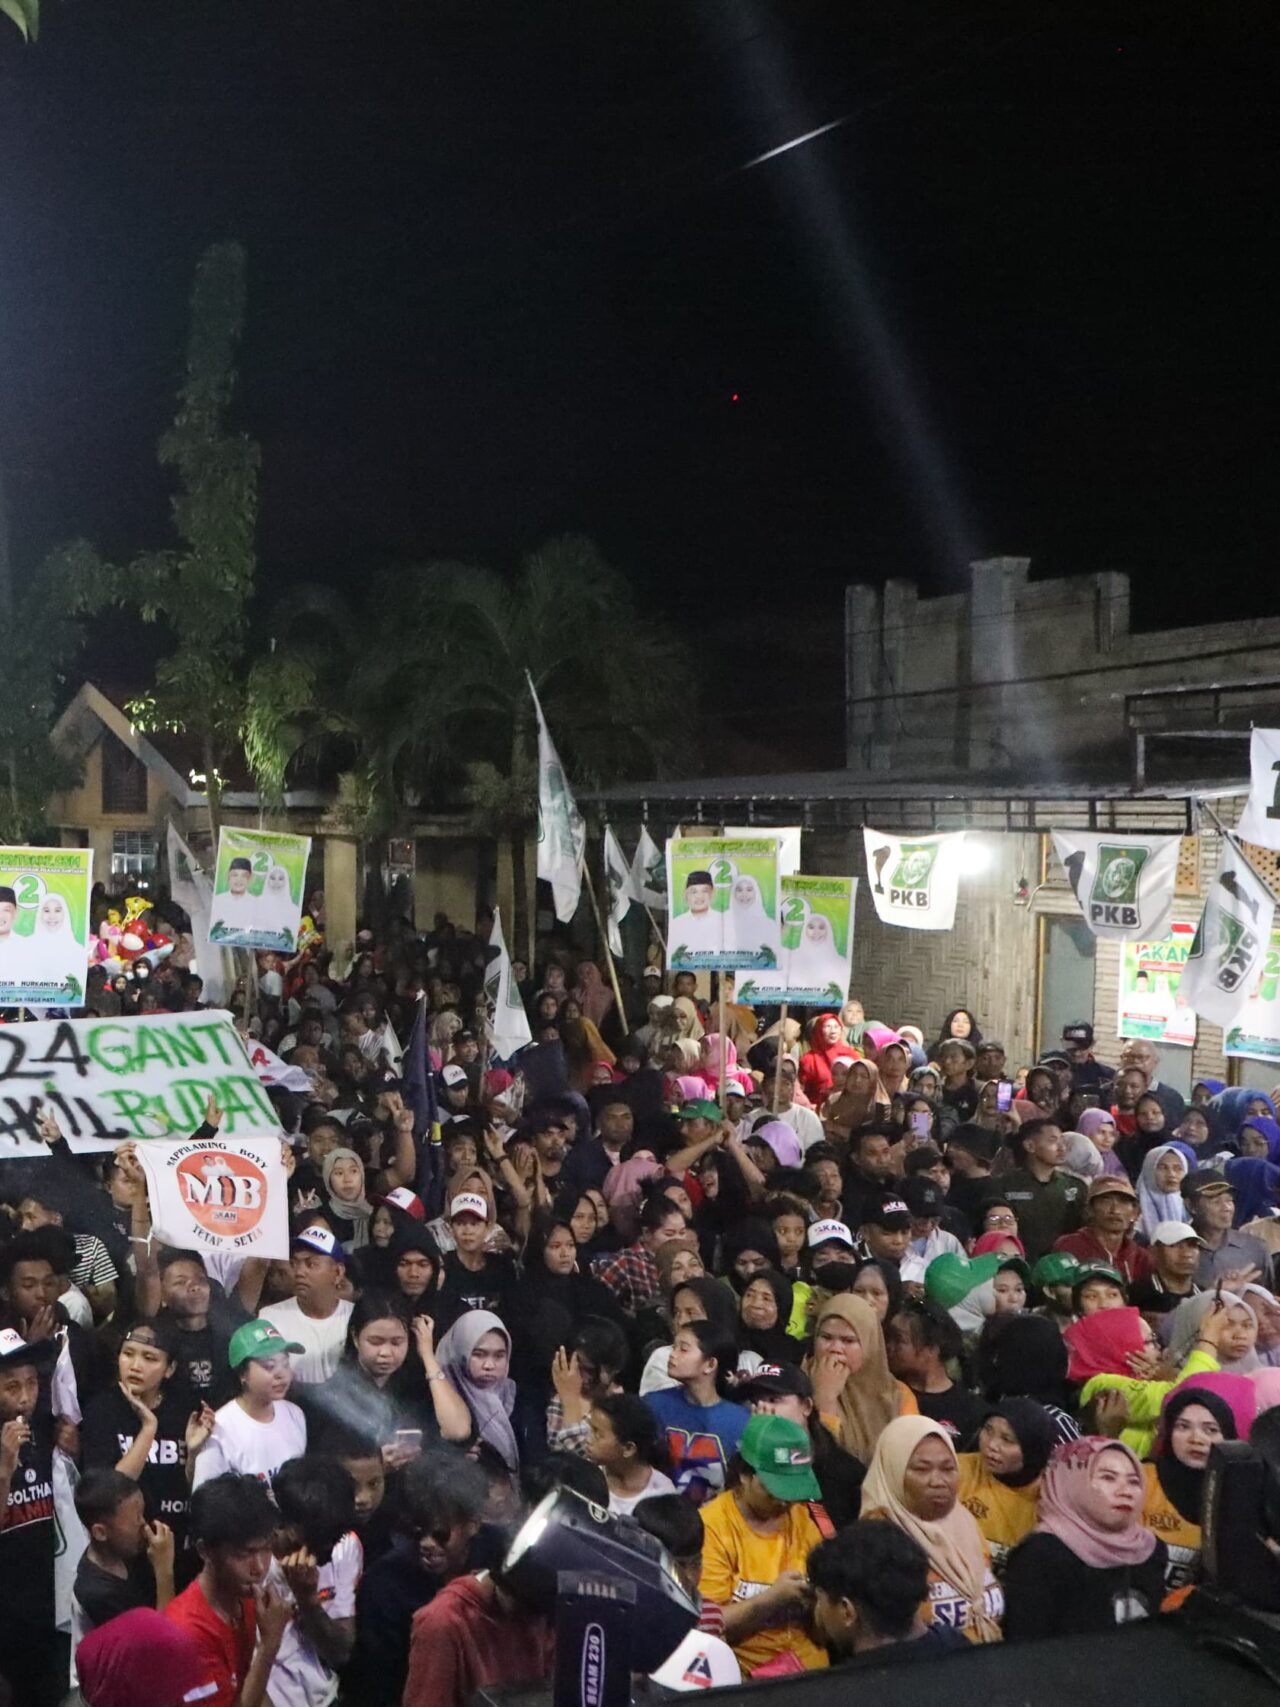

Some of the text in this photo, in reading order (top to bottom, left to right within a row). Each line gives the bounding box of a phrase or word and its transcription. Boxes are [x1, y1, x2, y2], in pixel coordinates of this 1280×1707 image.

[253, 851, 270, 873] 2
[714, 860, 733, 884] 2
[18, 876, 39, 903] 2
[890, 889, 928, 907] PKB
[785, 898, 805, 922] 2
[1091, 904, 1138, 925] PKB
[1219, 931, 1257, 988] PKB
[1263, 951, 1280, 974] 2
[586, 1635, 600, 1706] BEAM 230
